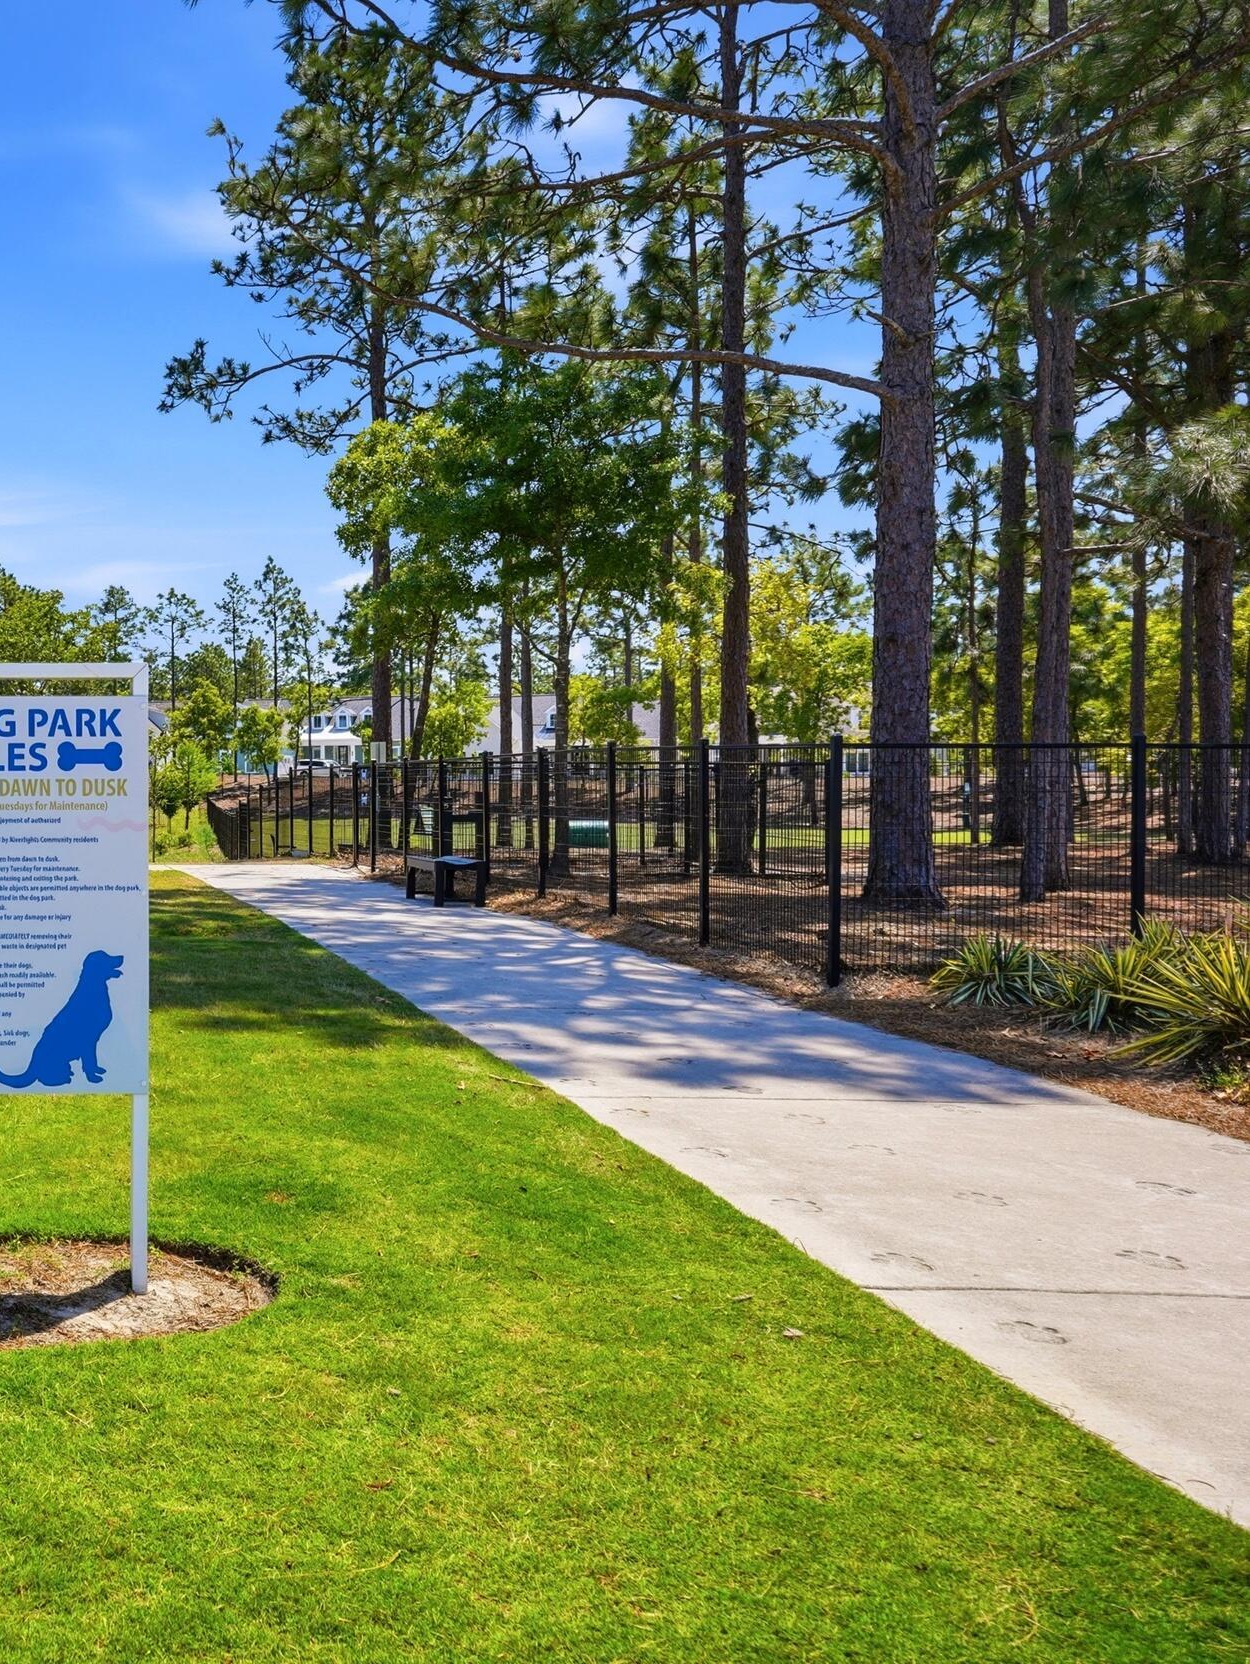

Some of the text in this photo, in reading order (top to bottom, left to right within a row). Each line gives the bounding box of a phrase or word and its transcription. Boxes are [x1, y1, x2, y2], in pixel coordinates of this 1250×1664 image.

[28, 708, 122, 737] PARK
[0, 778, 52, 797] DAWN
[55, 778, 77, 796] TO
[82, 778, 128, 797] DUSK
[34, 801, 47, 811] for
[49, 801, 109, 813] Maintenance)
